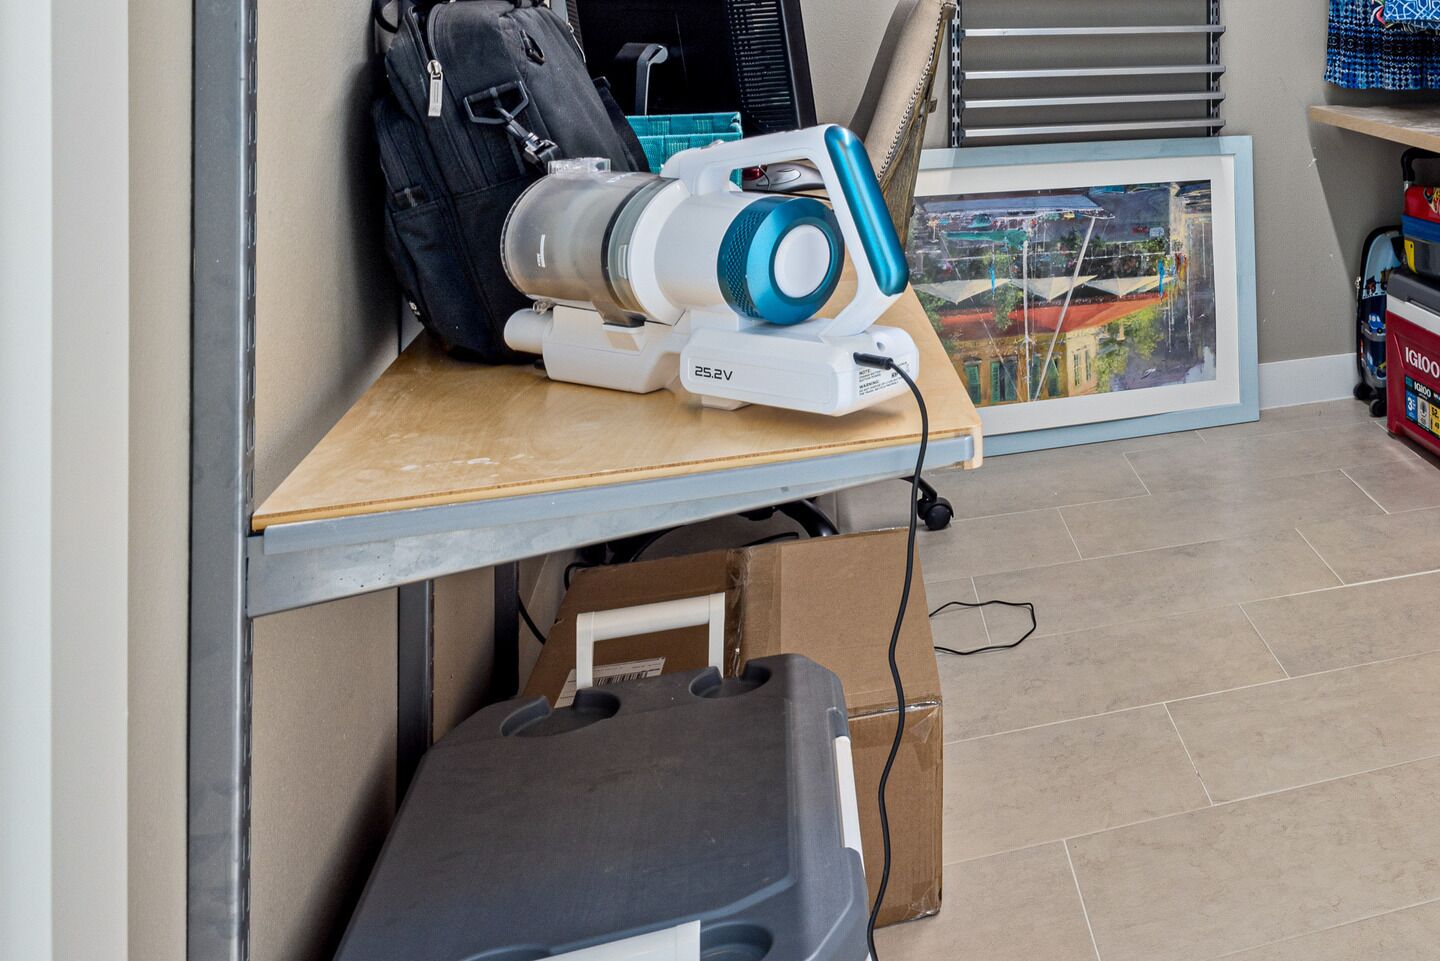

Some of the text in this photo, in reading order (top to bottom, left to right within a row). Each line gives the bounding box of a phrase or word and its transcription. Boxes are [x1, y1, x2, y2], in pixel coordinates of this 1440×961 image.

[1405, 346, 1440, 378] IGLOO
[694, 365, 733, 381] 25.2V
[1414, 381, 1432, 398] IGLOO
